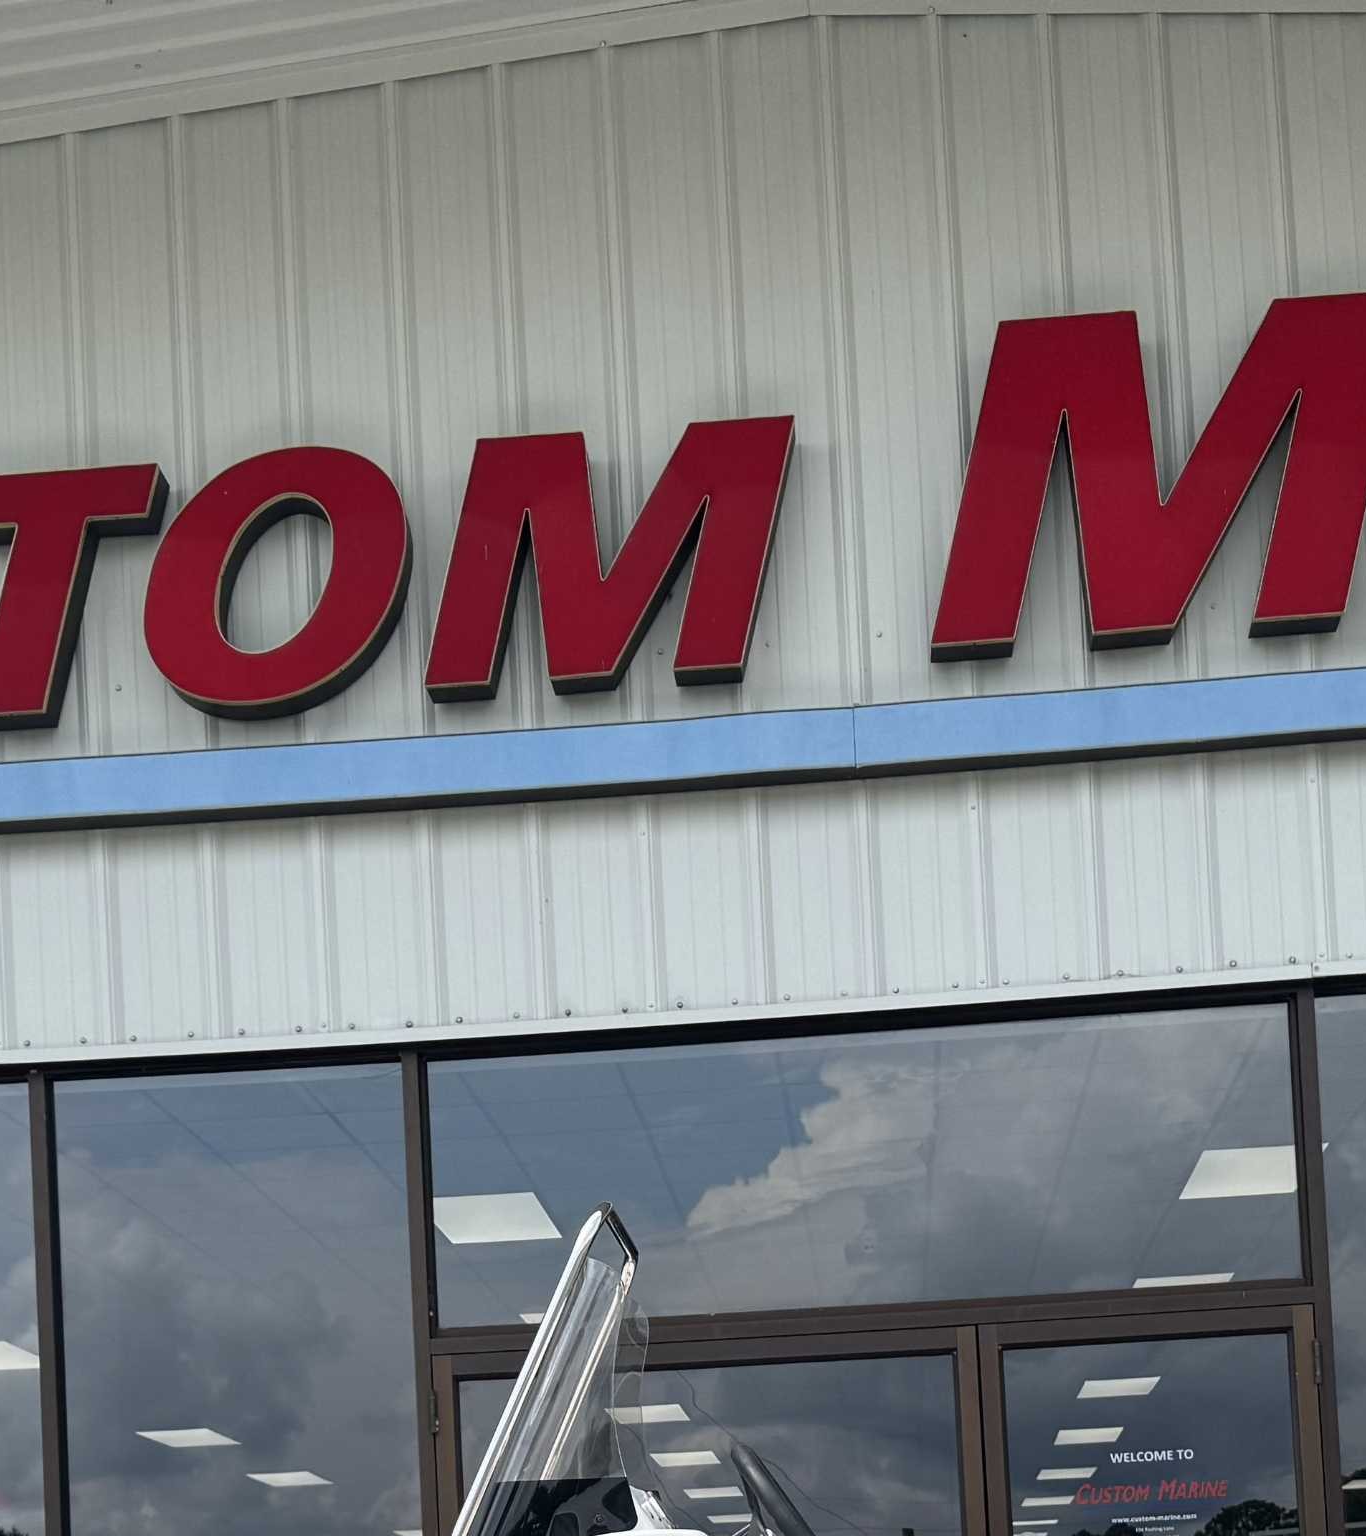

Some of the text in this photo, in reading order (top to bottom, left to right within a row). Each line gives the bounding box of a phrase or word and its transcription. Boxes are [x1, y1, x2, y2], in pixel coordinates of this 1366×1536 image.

[1110, 1449, 1194, 1464] WELCOME TO
[1075, 1479, 1228, 1505] CUSTOM MARINE
